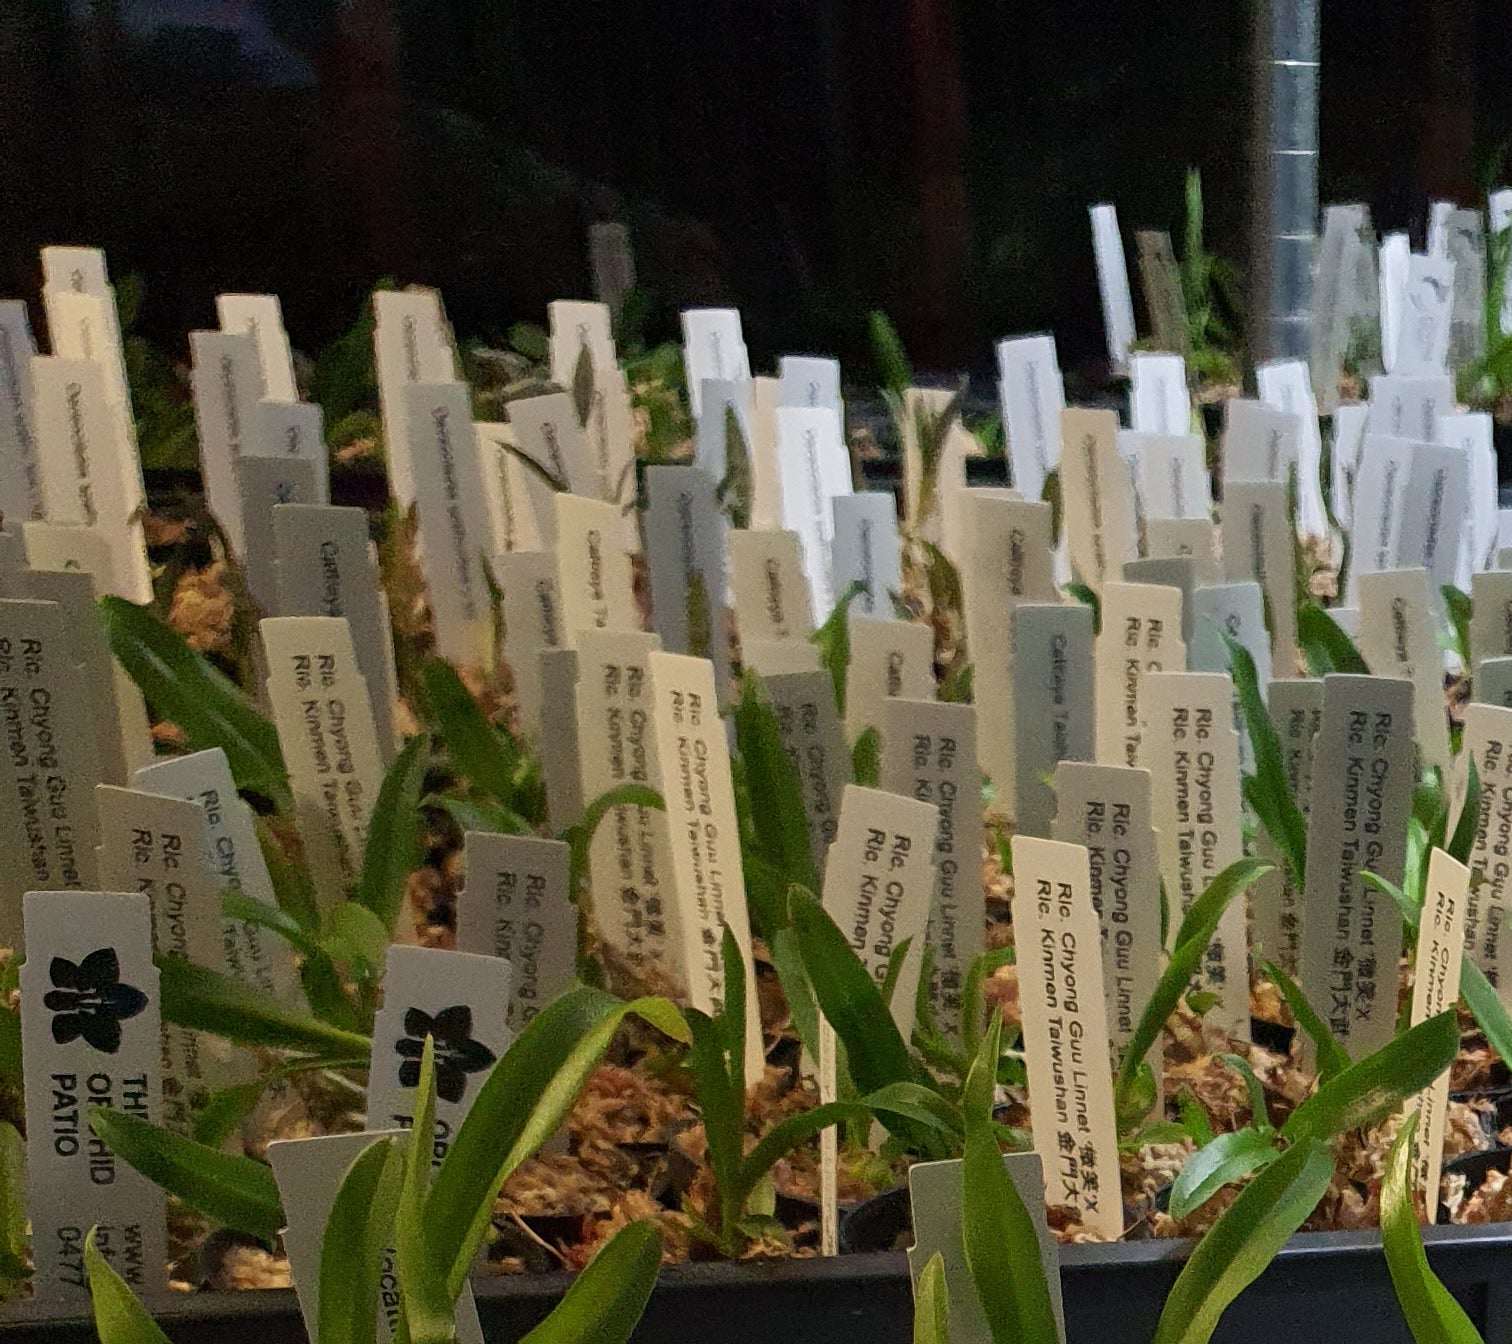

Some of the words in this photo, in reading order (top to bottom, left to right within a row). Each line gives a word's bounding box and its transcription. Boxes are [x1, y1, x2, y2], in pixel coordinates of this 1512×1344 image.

[1174, 751, 1194, 823] Kinmen
[1196, 752, 1215, 825] Chyong
[1343, 757, 1364, 832] Kinmen
[1364, 757, 1389, 837] Chyong
[1475, 782, 1496, 851] Kinmen
[1111, 849, 1131, 923] Chyong
[1178, 829, 1194, 915] Taiwusha
[1201, 831, 1217, 869] Guu
[1493, 861, 1510, 900] Guu
[849, 874, 878, 950] Kinmen
[875, 881, 904, 957] Chyong
[1463, 857, 1488, 950] Tawushan
[1037, 928, 1058, 1008] Kinmen
[1059, 931, 1078, 1015] Chyong
[1115, 930, 1133, 969] Guu
[1432, 947, 1449, 1018] Chyon
[1046, 1016, 1068, 1123] Taiwushan
[1067, 1022, 1084, 1062] Guu
[51, 1073, 79, 1157] PATIO
[86, 1073, 115, 1185] OHID
[1072, 1070, 1092, 1133] Linnet
[1058, 1131, 1079, 1203] 金門大
